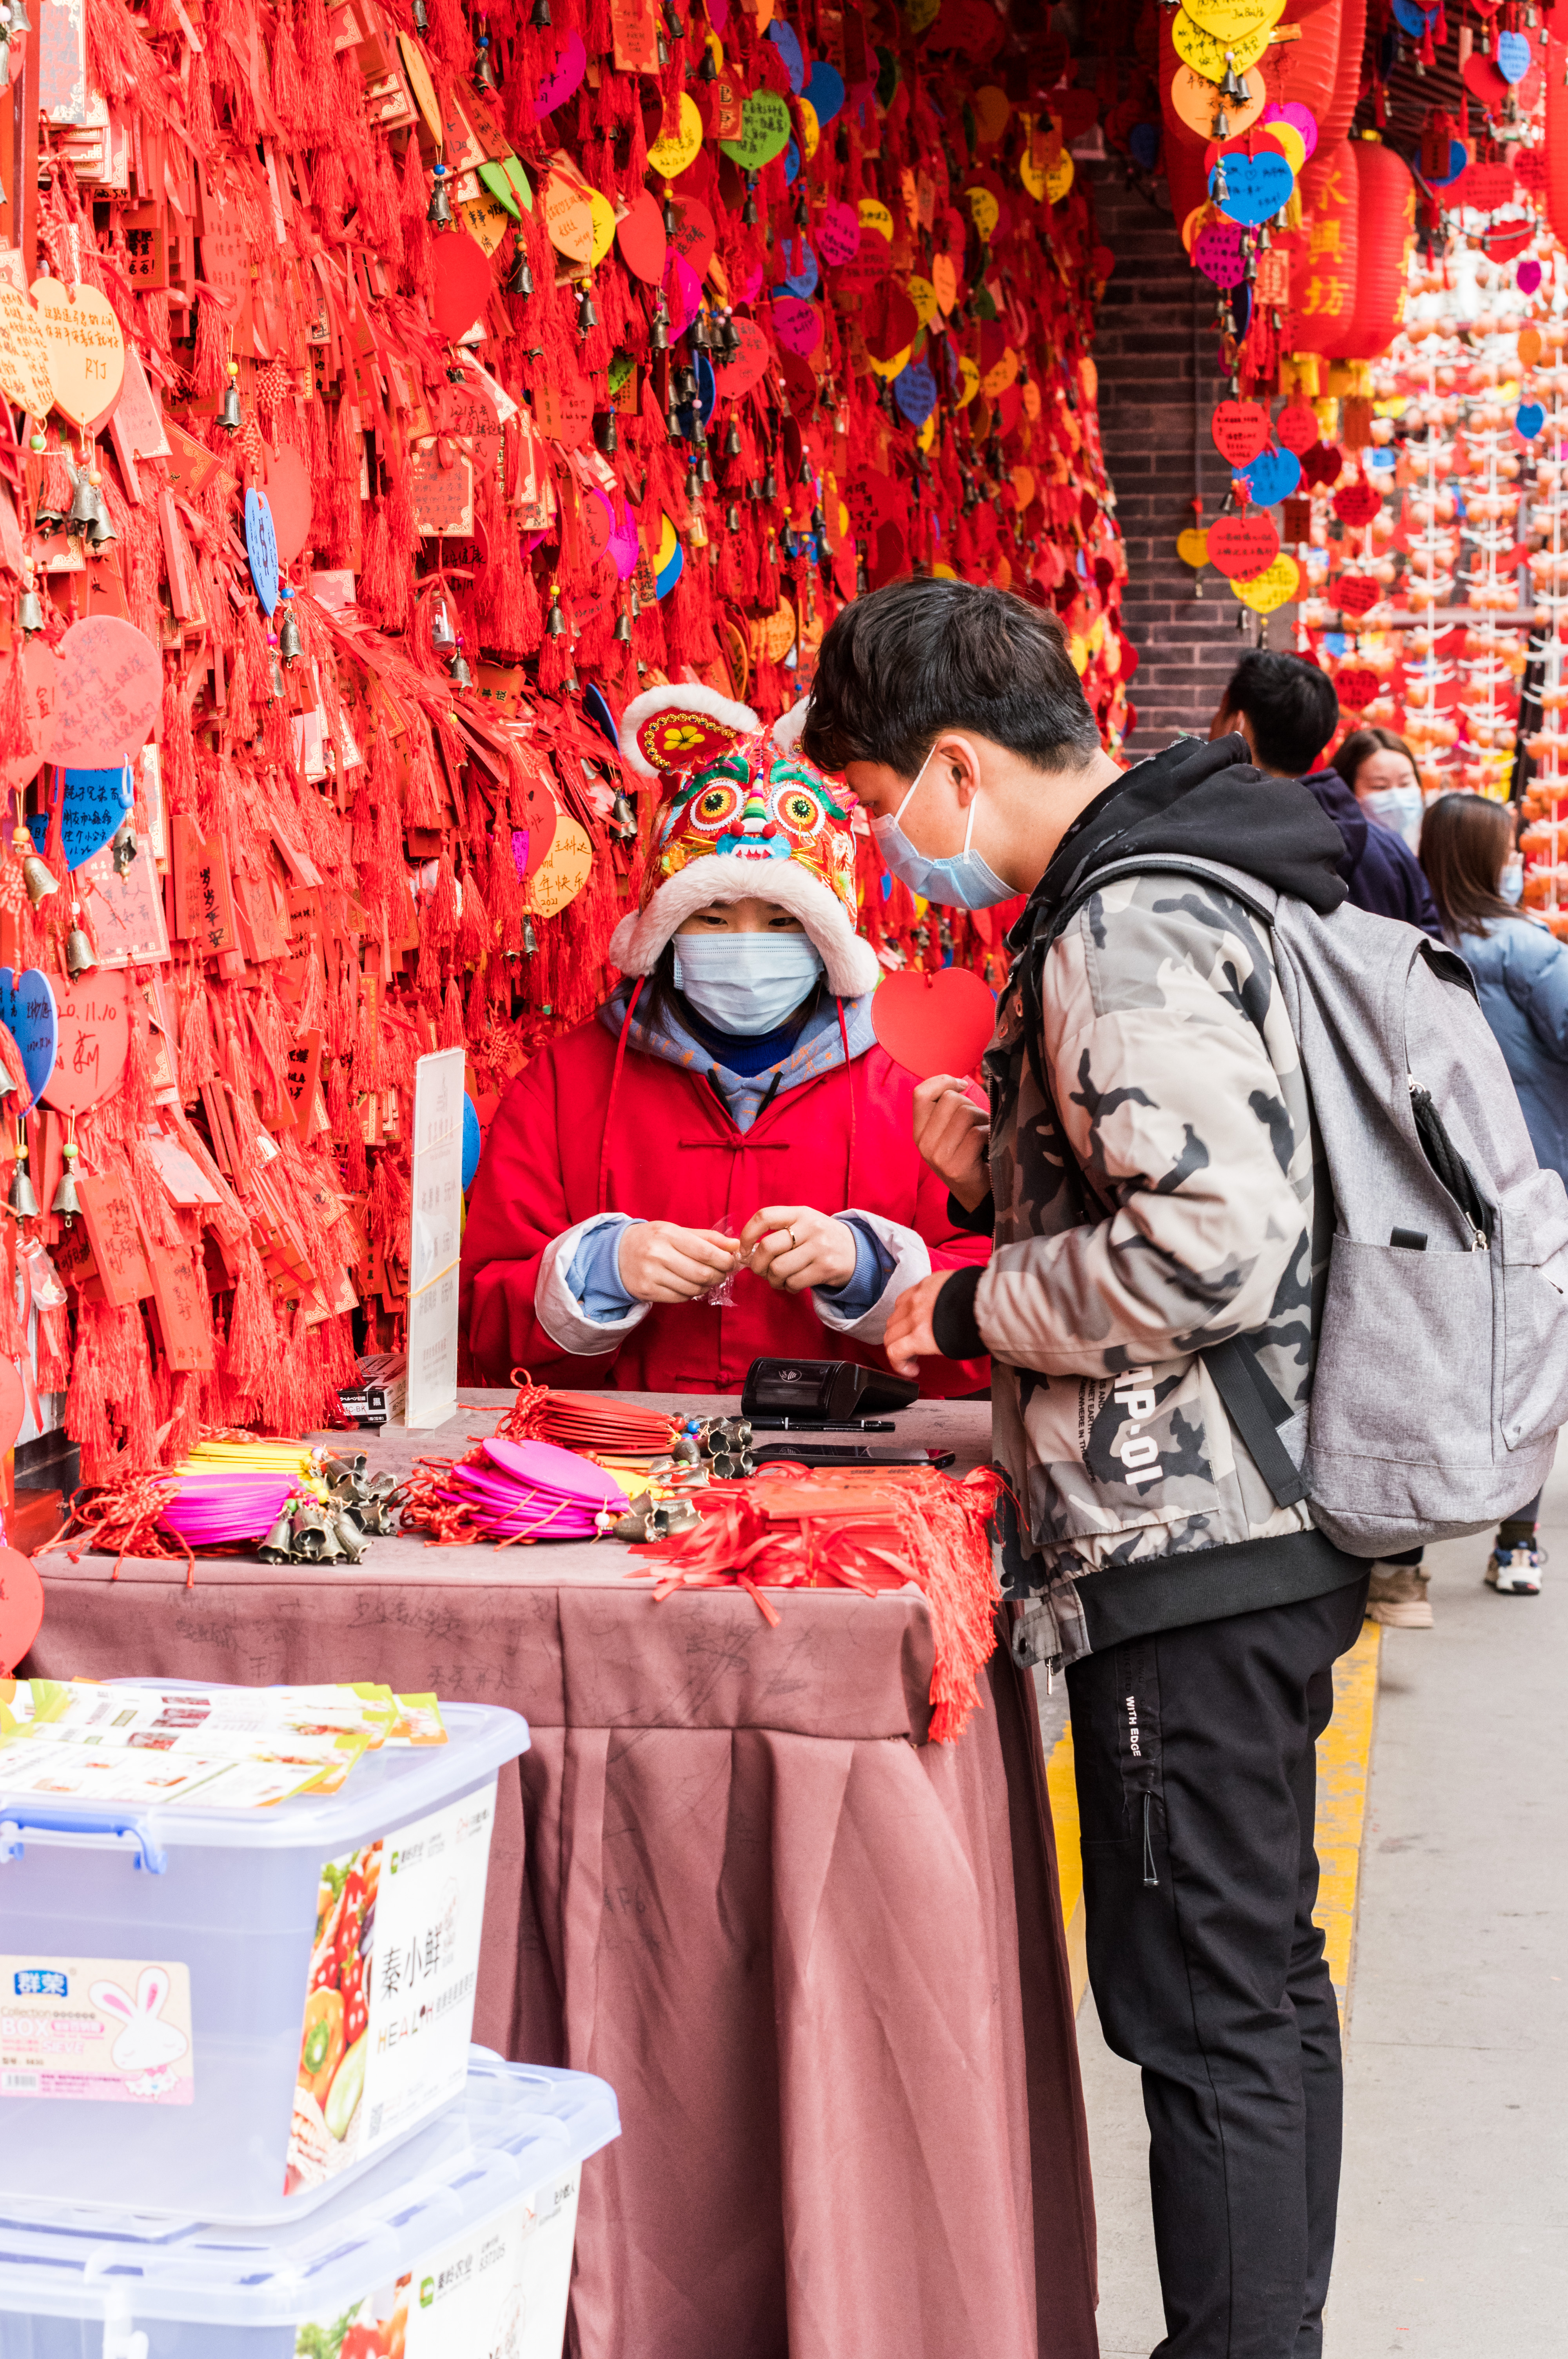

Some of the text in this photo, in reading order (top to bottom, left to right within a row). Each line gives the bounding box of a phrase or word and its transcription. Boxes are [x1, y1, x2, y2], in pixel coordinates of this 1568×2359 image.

[85, 358, 107, 380] RYJ
[200, 867, 224, 948] 岁岁平安
[540, 898, 558, 906] 2021
[1125, 1696, 1141, 1757] WITH EDGE
[380, 1924, 442, 2001] 秦小鲜
[18, 1972, 65, 1994] 群荣
[1, 2006, 50, 2017] Collection
[2, 2017, 49, 2037] BOX
[42, 2041, 85, 2054] SIEVE
